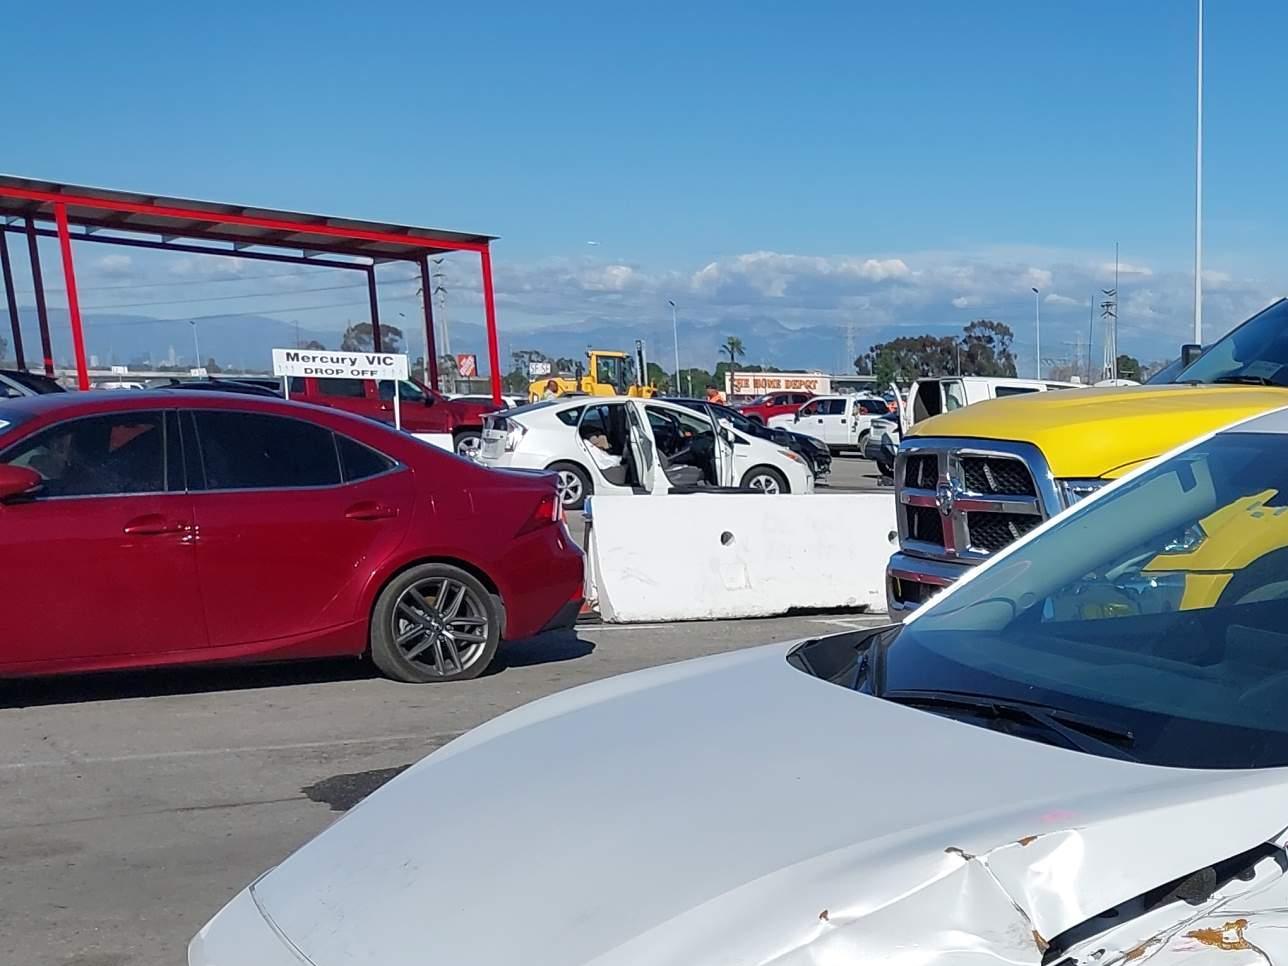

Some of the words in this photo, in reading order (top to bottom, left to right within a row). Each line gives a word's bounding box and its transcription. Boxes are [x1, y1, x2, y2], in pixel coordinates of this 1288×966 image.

[286, 352, 357, 366] Mercury
[365, 355, 394, 366] VIC
[304, 367, 344, 375] DROP
[350, 369, 378, 377] OFF
[753, 378, 782, 389] HOME
[784, 379, 817, 390] DEPOT
